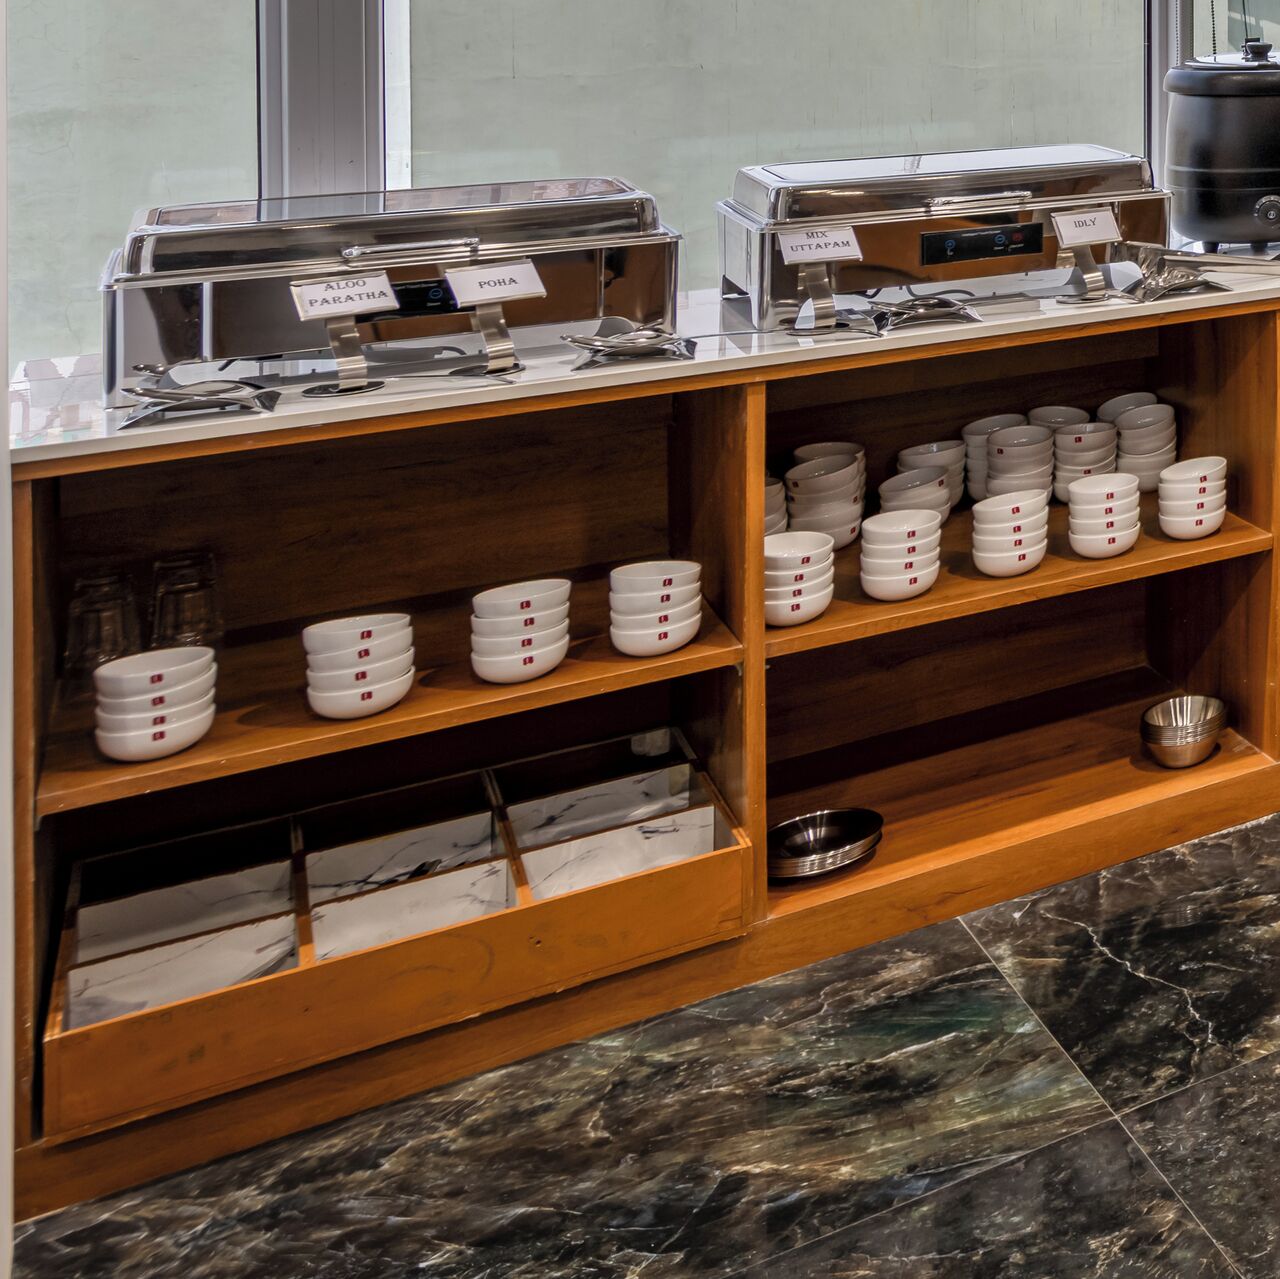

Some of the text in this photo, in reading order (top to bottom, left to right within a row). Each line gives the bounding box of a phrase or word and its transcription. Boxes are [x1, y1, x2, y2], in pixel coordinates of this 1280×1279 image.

[1073, 217, 1098, 229] IDLY
[805, 231, 829, 240] MIX
[790, 240, 851, 252] UTTAPAM
[324, 279, 367, 292] ALOO
[478, 276, 519, 290] POHA
[308, 290, 389, 308] PARATHA
